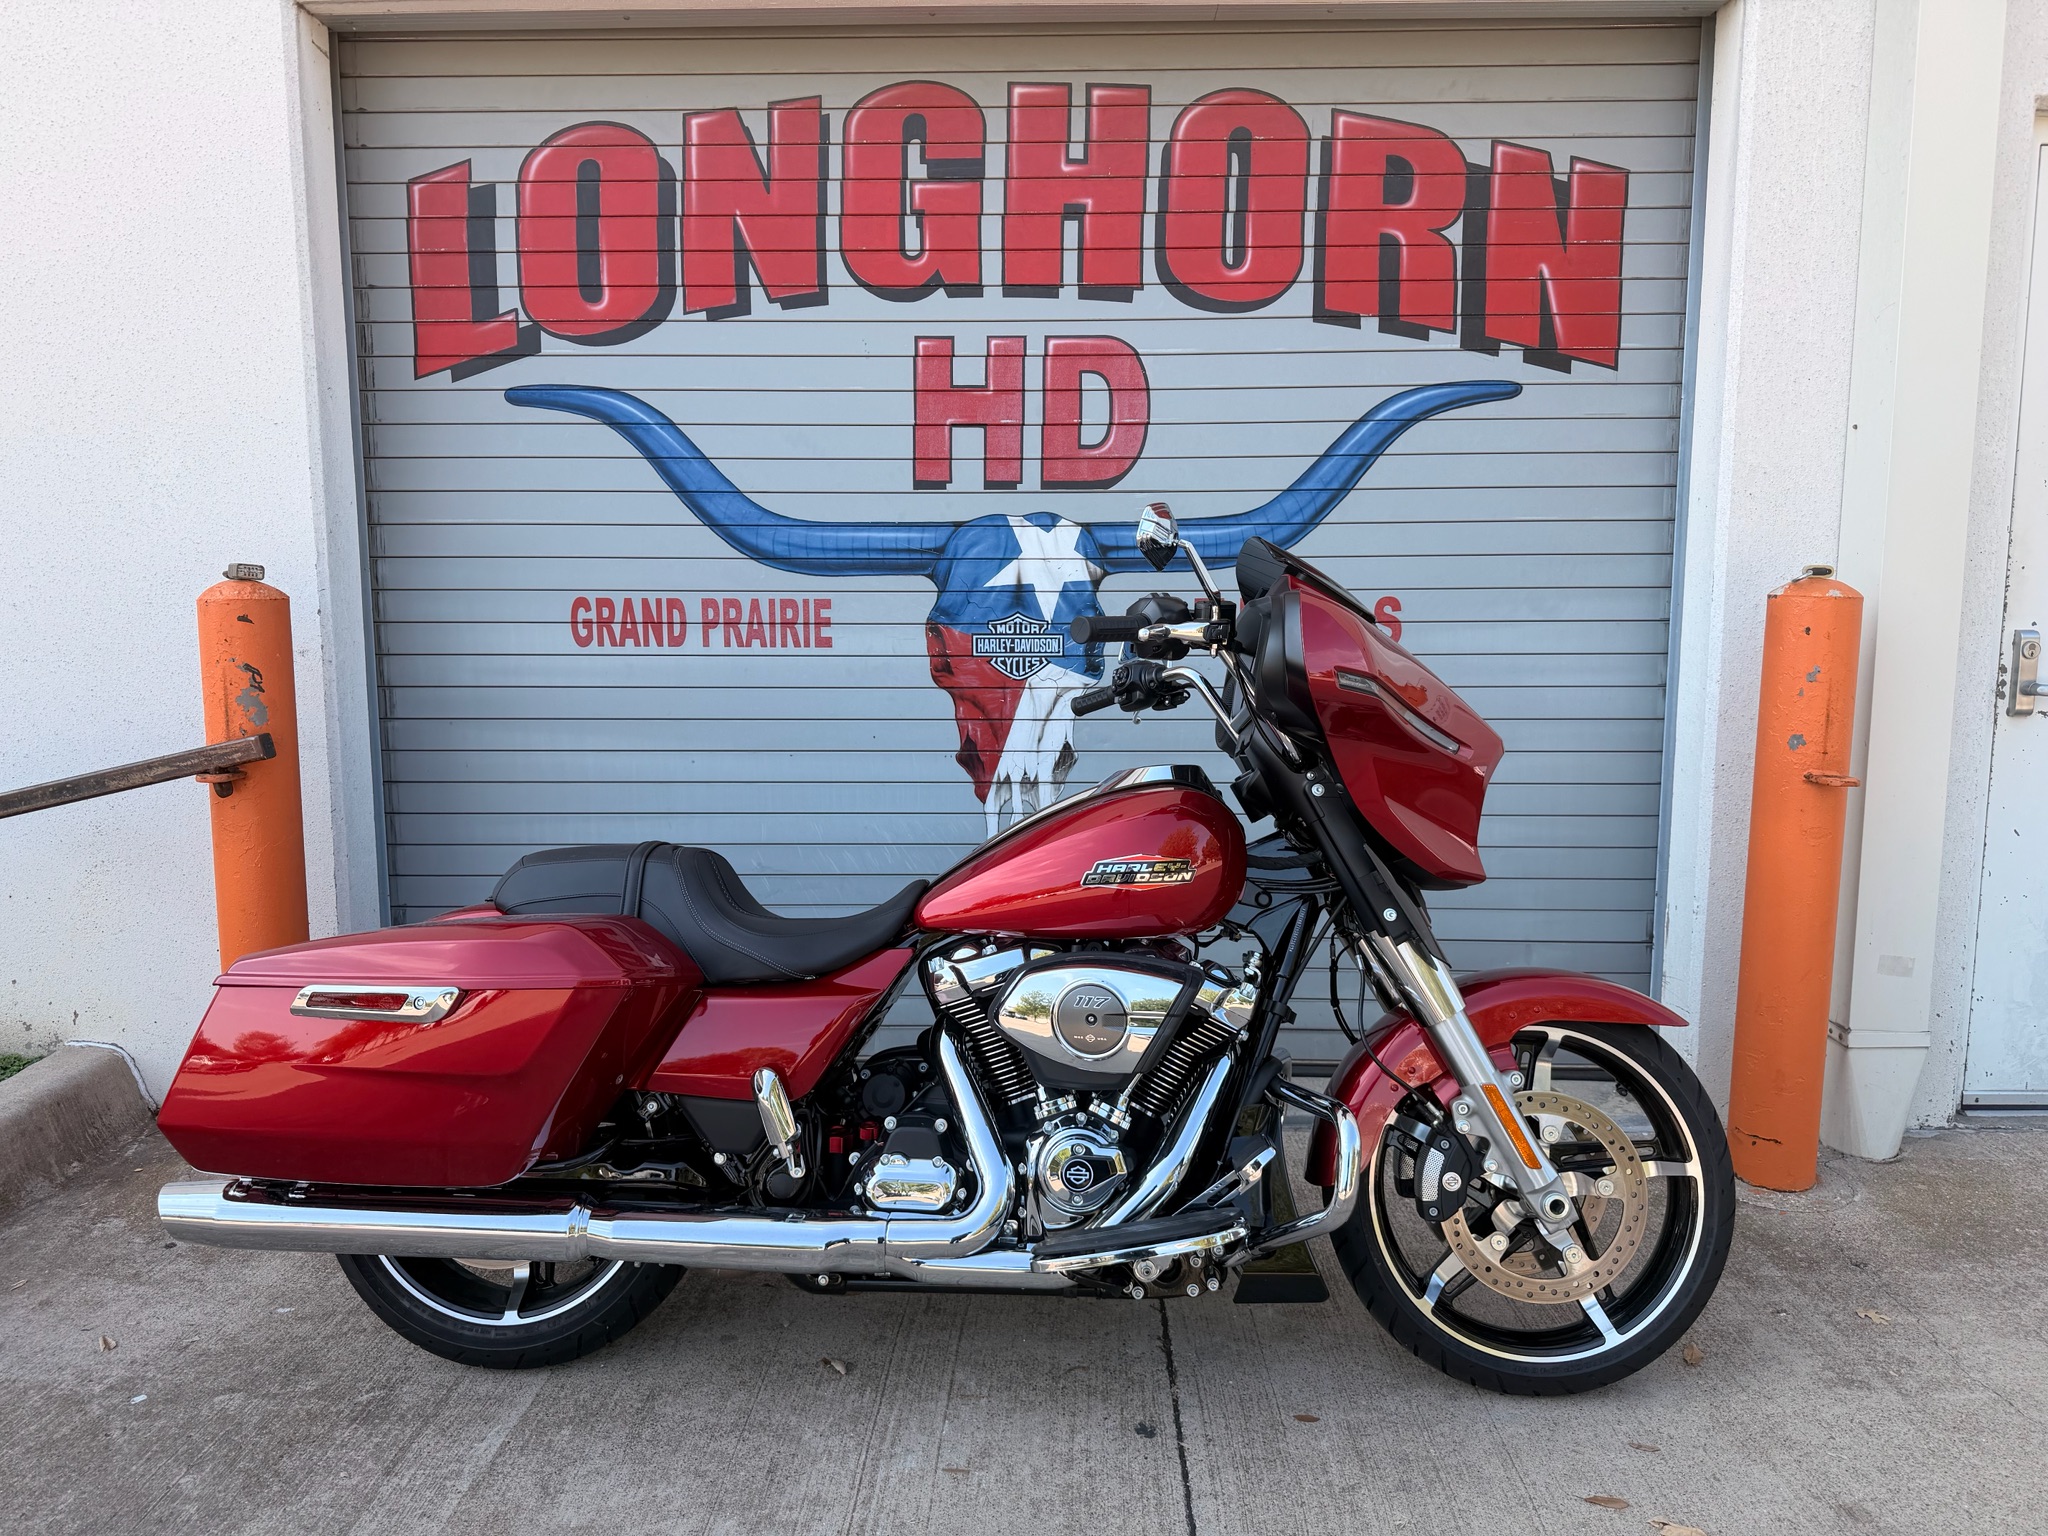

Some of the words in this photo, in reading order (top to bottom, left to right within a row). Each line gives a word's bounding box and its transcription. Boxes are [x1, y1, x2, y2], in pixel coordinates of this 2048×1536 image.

[407, 81, 1630, 381] LONGHORN
[912, 335, 1151, 491] HD
[570, 596, 688, 648] GRAND
[700, 597, 833, 648] PRAIRIE
[996, 617, 1040, 634] MOTOR
[977, 638, 1059, 653] HARLEY-DAVIDSON
[997, 656, 1040, 676] CYCLES
[1096, 862, 1187, 873] HARLEY-
[1085, 871, 1192, 884] DAVIDSON
[1073, 994, 1112, 1008] 117
